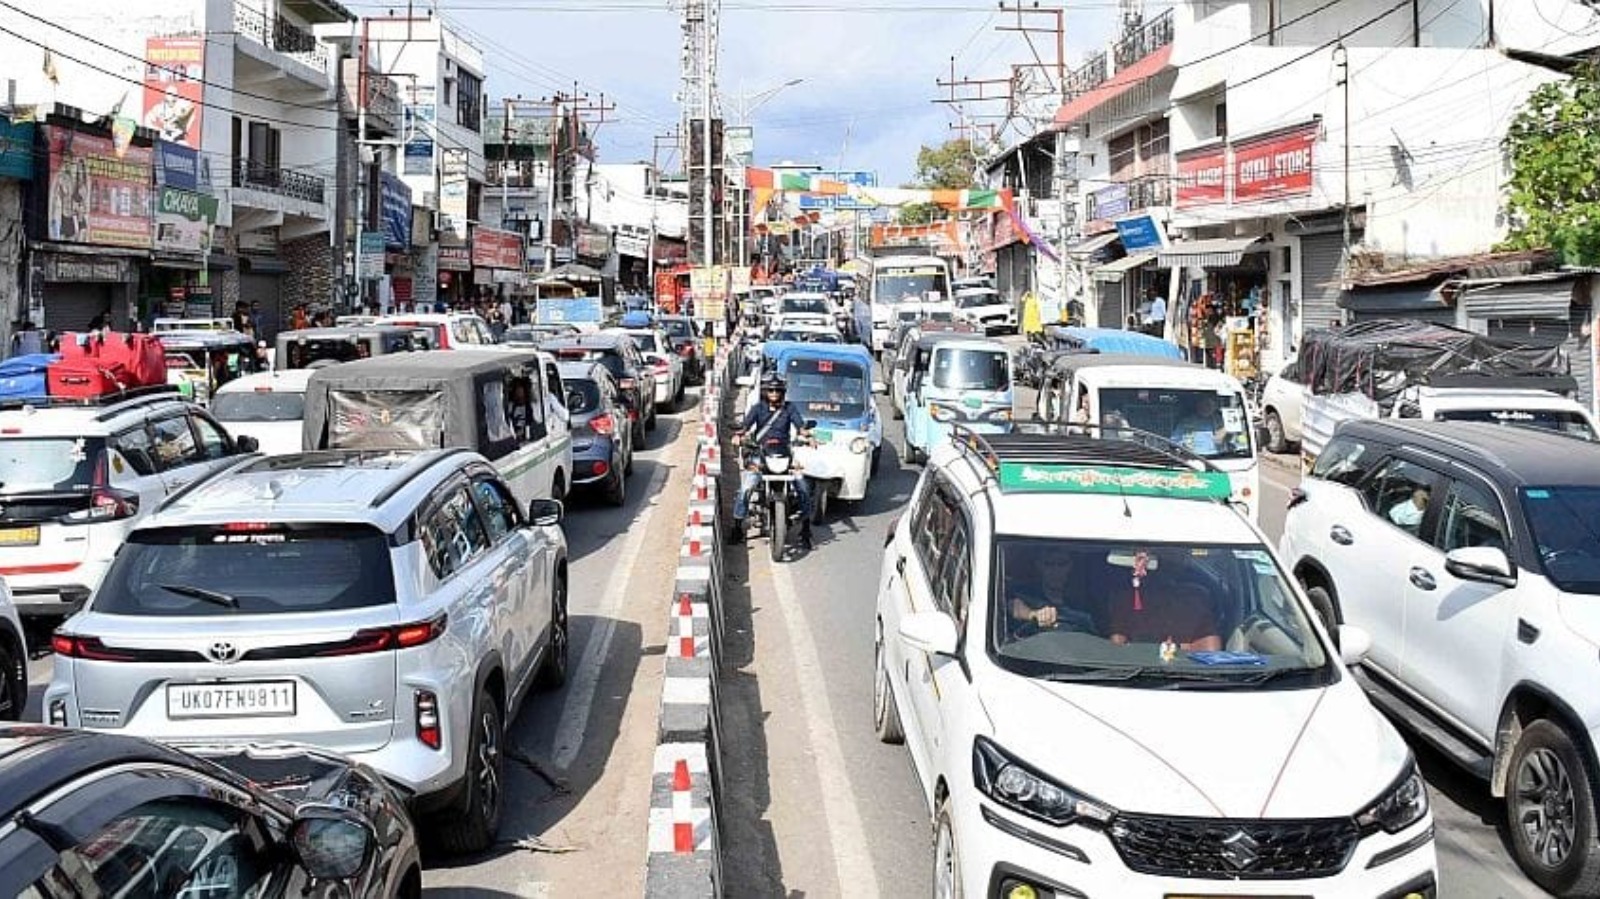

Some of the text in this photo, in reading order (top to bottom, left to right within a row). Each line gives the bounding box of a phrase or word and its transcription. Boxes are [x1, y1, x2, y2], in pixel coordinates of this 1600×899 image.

[1274, 147, 1310, 179] STORE
[163, 190, 199, 214] OKAYA
[181, 687, 290, 709] UK07FN9811
